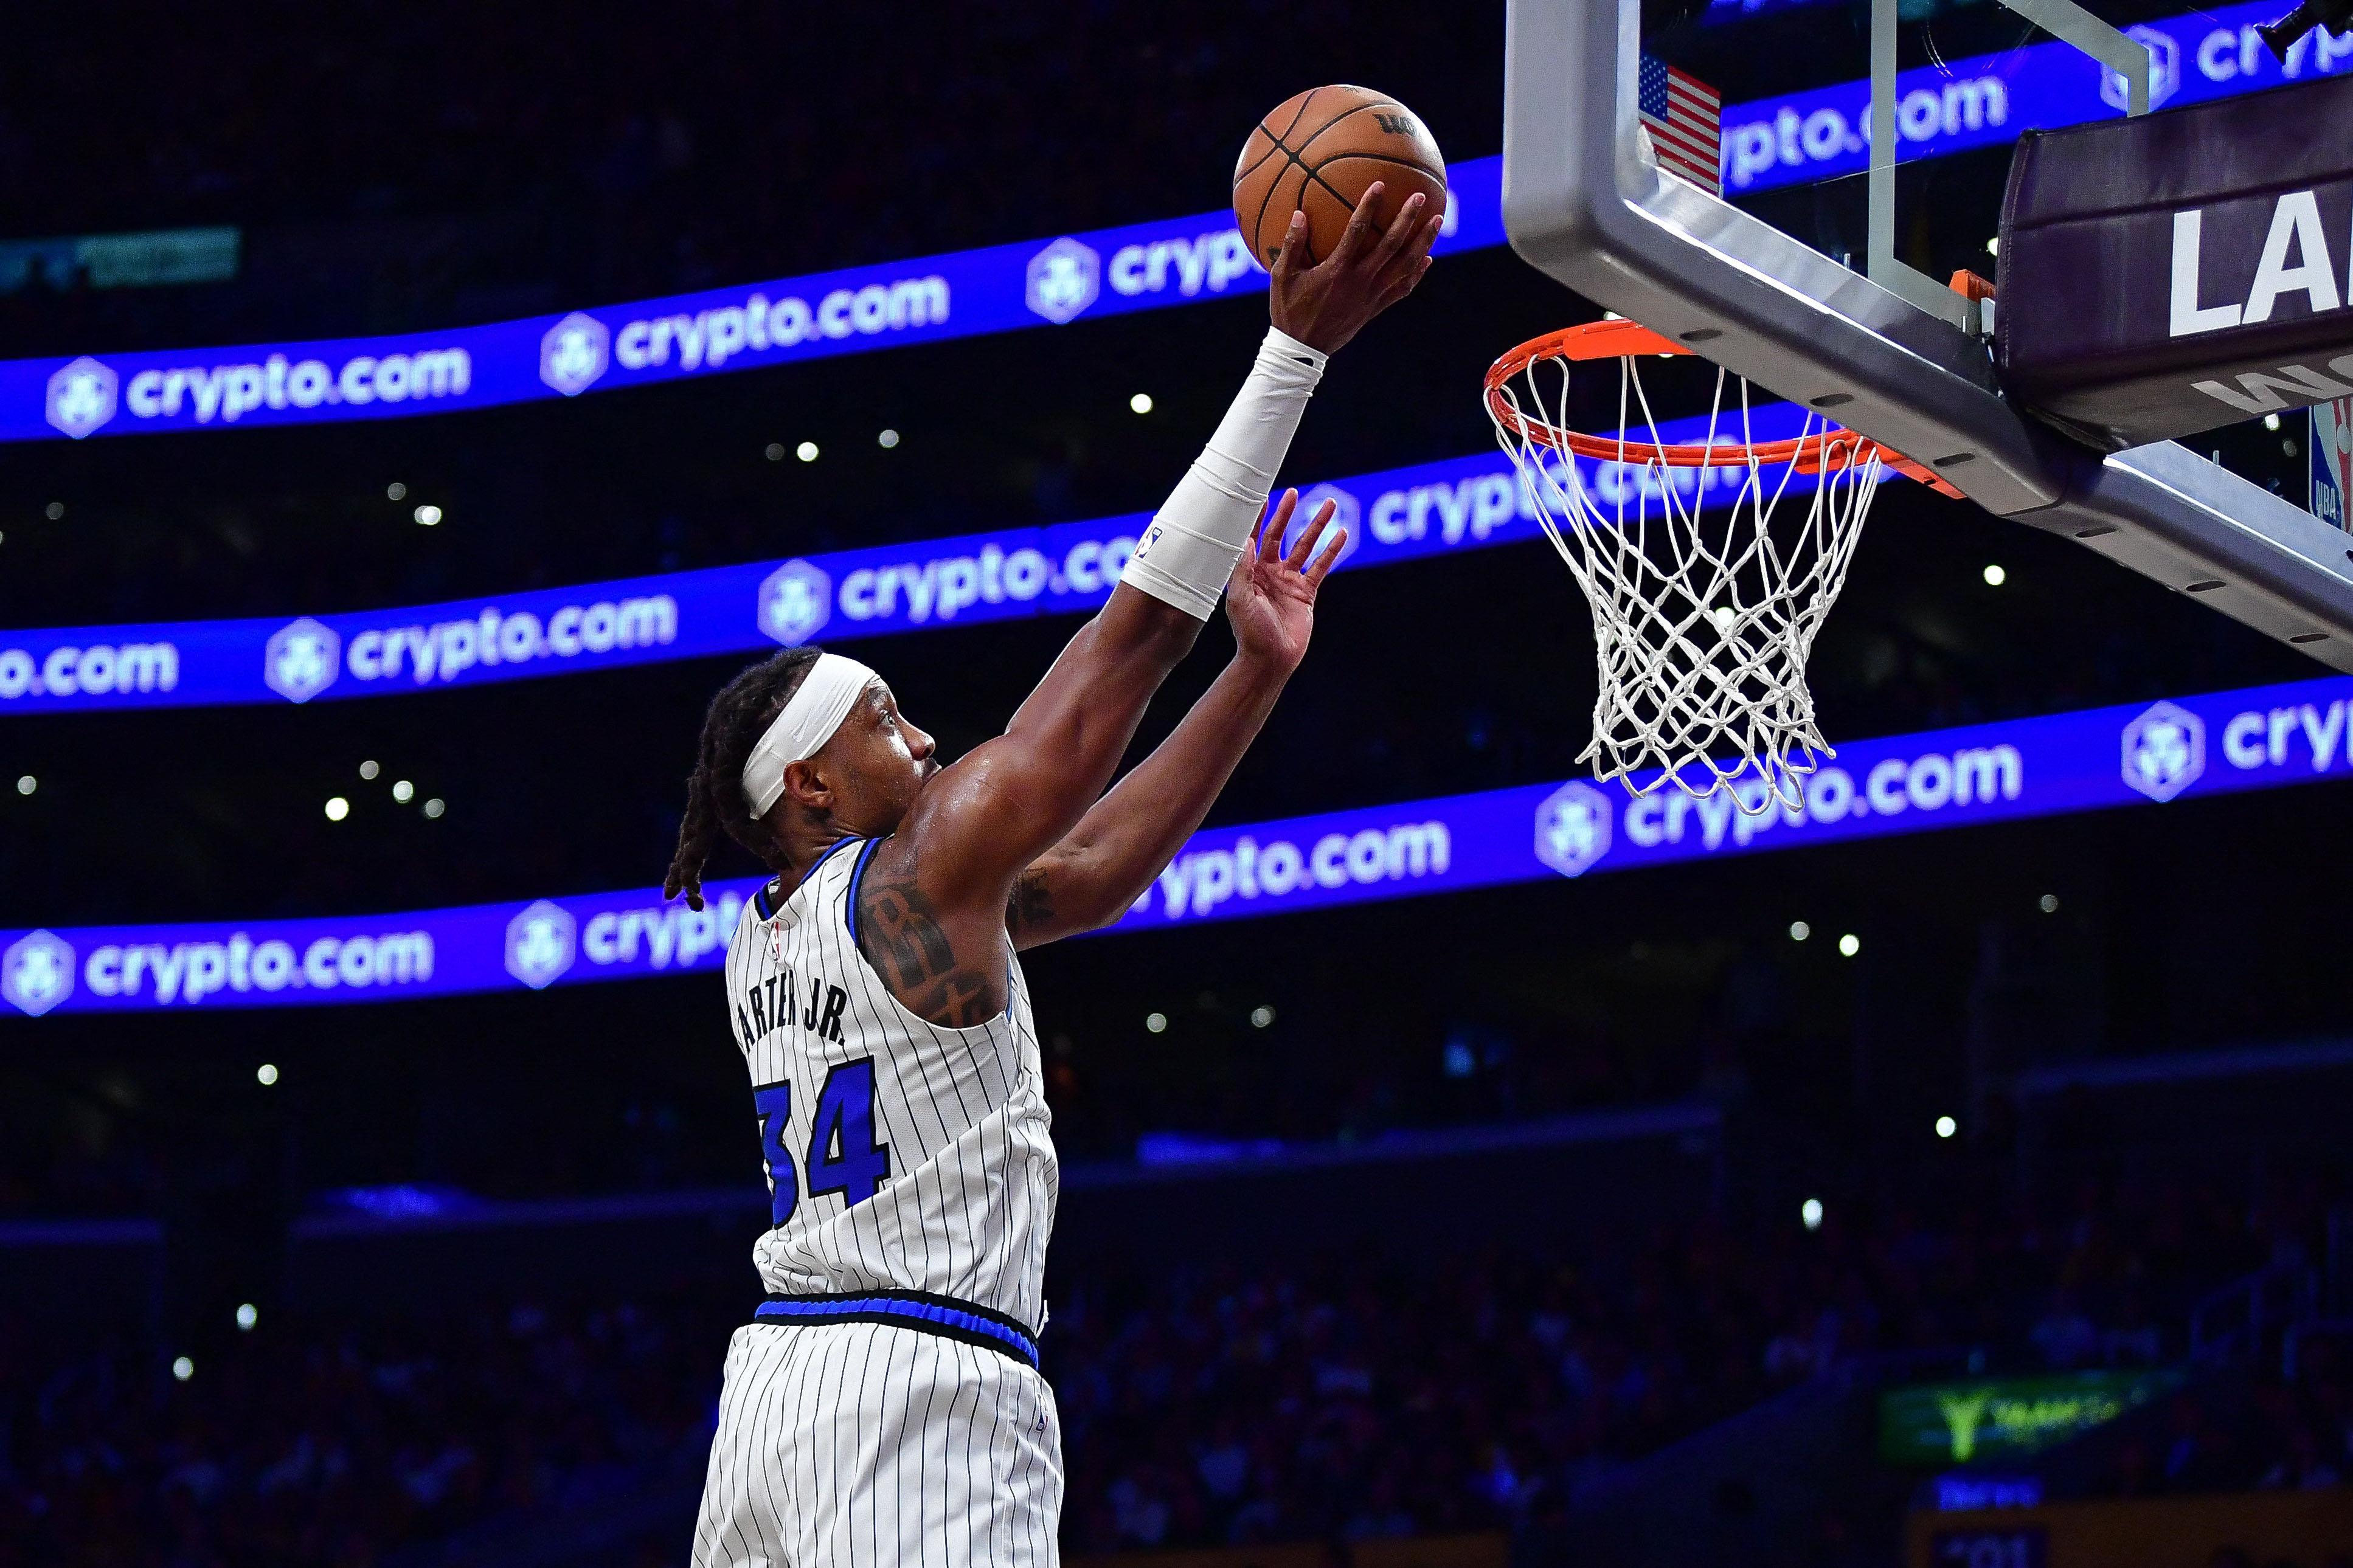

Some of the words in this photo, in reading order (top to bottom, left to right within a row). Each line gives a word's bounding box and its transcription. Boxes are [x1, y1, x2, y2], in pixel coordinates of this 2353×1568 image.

[1109, 229, 1268, 297] cryp
[2169, 190, 2353, 337] LA
[616, 275, 950, 371] crypto.com
[127, 347, 471, 424] crypto.com
[839, 535, 1138, 623] crypto.co
[347, 596, 677, 684] crypto.com
[2223, 699, 2353, 772] cry
[1624, 744, 2023, 851] crypto.com
[1128, 820, 1452, 919] ypto.com
[84, 930, 435, 1005] crypto.com
[583, 890, 743, 970] crypt
[804, 977, 846, 1046] JR.
[753, 1055, 891, 1230] 34
